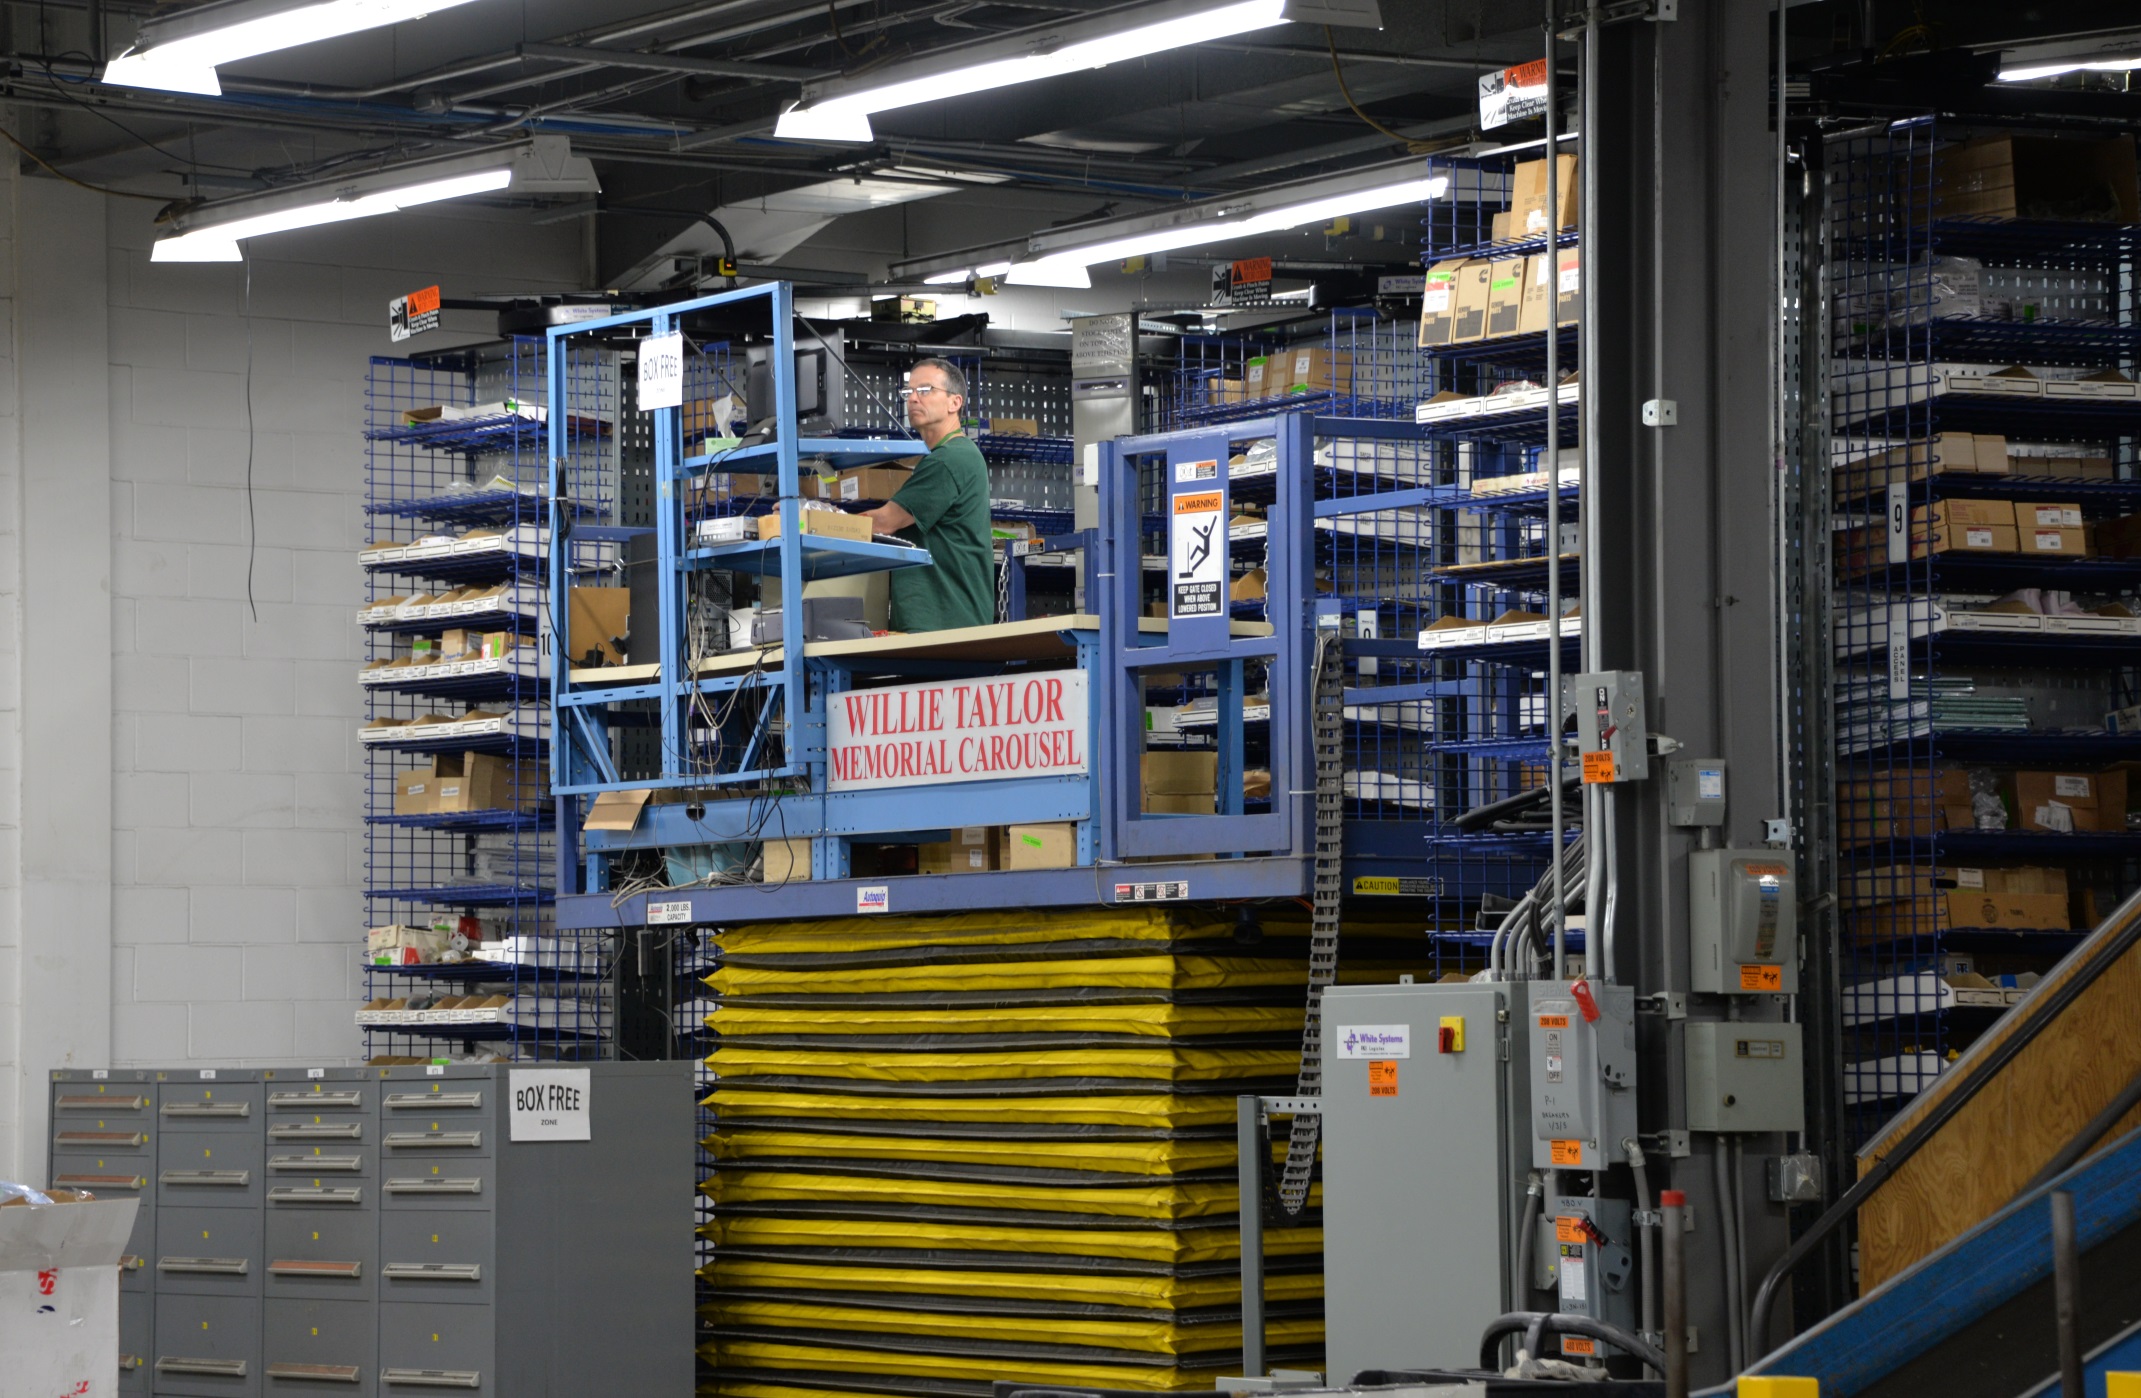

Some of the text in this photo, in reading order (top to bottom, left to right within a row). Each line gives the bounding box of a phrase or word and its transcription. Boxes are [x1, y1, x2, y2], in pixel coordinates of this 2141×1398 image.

[1520, 61, 1546, 78] WARNIN
[644, 354, 678, 381] BOX FREE
[1186, 498, 1218, 509] WARNING
[1895, 504, 1902, 533] 9
[1178, 583, 1216, 594] KEEP GATE CLOSED
[1184, 594, 1210, 603] WHEN ABOVE
[1178, 603, 1216, 613] LOWERED POSITION
[1599, 688, 1605, 702] ON
[845, 679, 1064, 738] WILLIE TAYLOR
[831, 730, 1081, 782] MEMORIAL CAROUSEL
[1596, 753, 1611, 761] VOLTS
[1364, 881, 1397, 890] CAUTION
[863, 890, 886, 903] Autoquip
[666, 904, 679, 912] 2,000
[667, 913, 686, 921] CAPACITY
[1360, 1033, 1403, 1045] White Systems
[517, 1085, 580, 1111] BOX FREE
[1545, 1095, 1555, 1106] P-1
[1575, 1342, 1590, 1351] VOLTS
